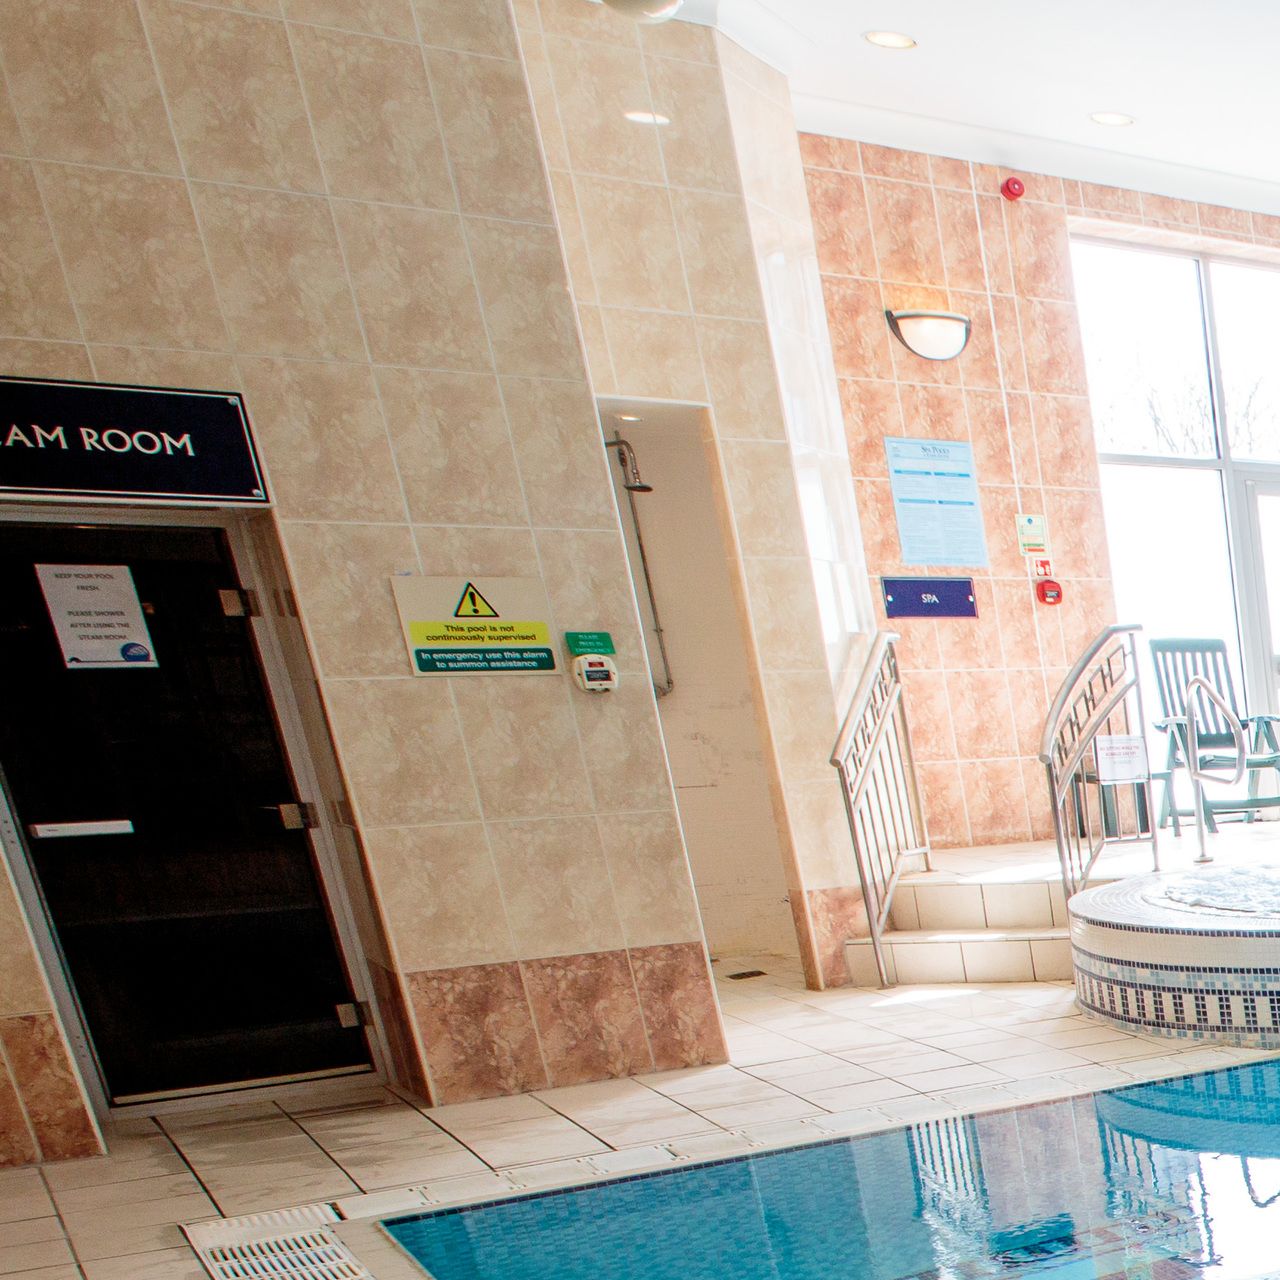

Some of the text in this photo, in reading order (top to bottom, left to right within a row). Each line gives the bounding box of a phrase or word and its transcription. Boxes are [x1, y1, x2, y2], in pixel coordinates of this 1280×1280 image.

[0, 424, 195, 456] AM ROOM
[921, 593, 939, 603] SPA
[467, 625, 487, 634] pool
[426, 634, 537, 642] continuously supervised
[433, 653, 483, 661] emergency
